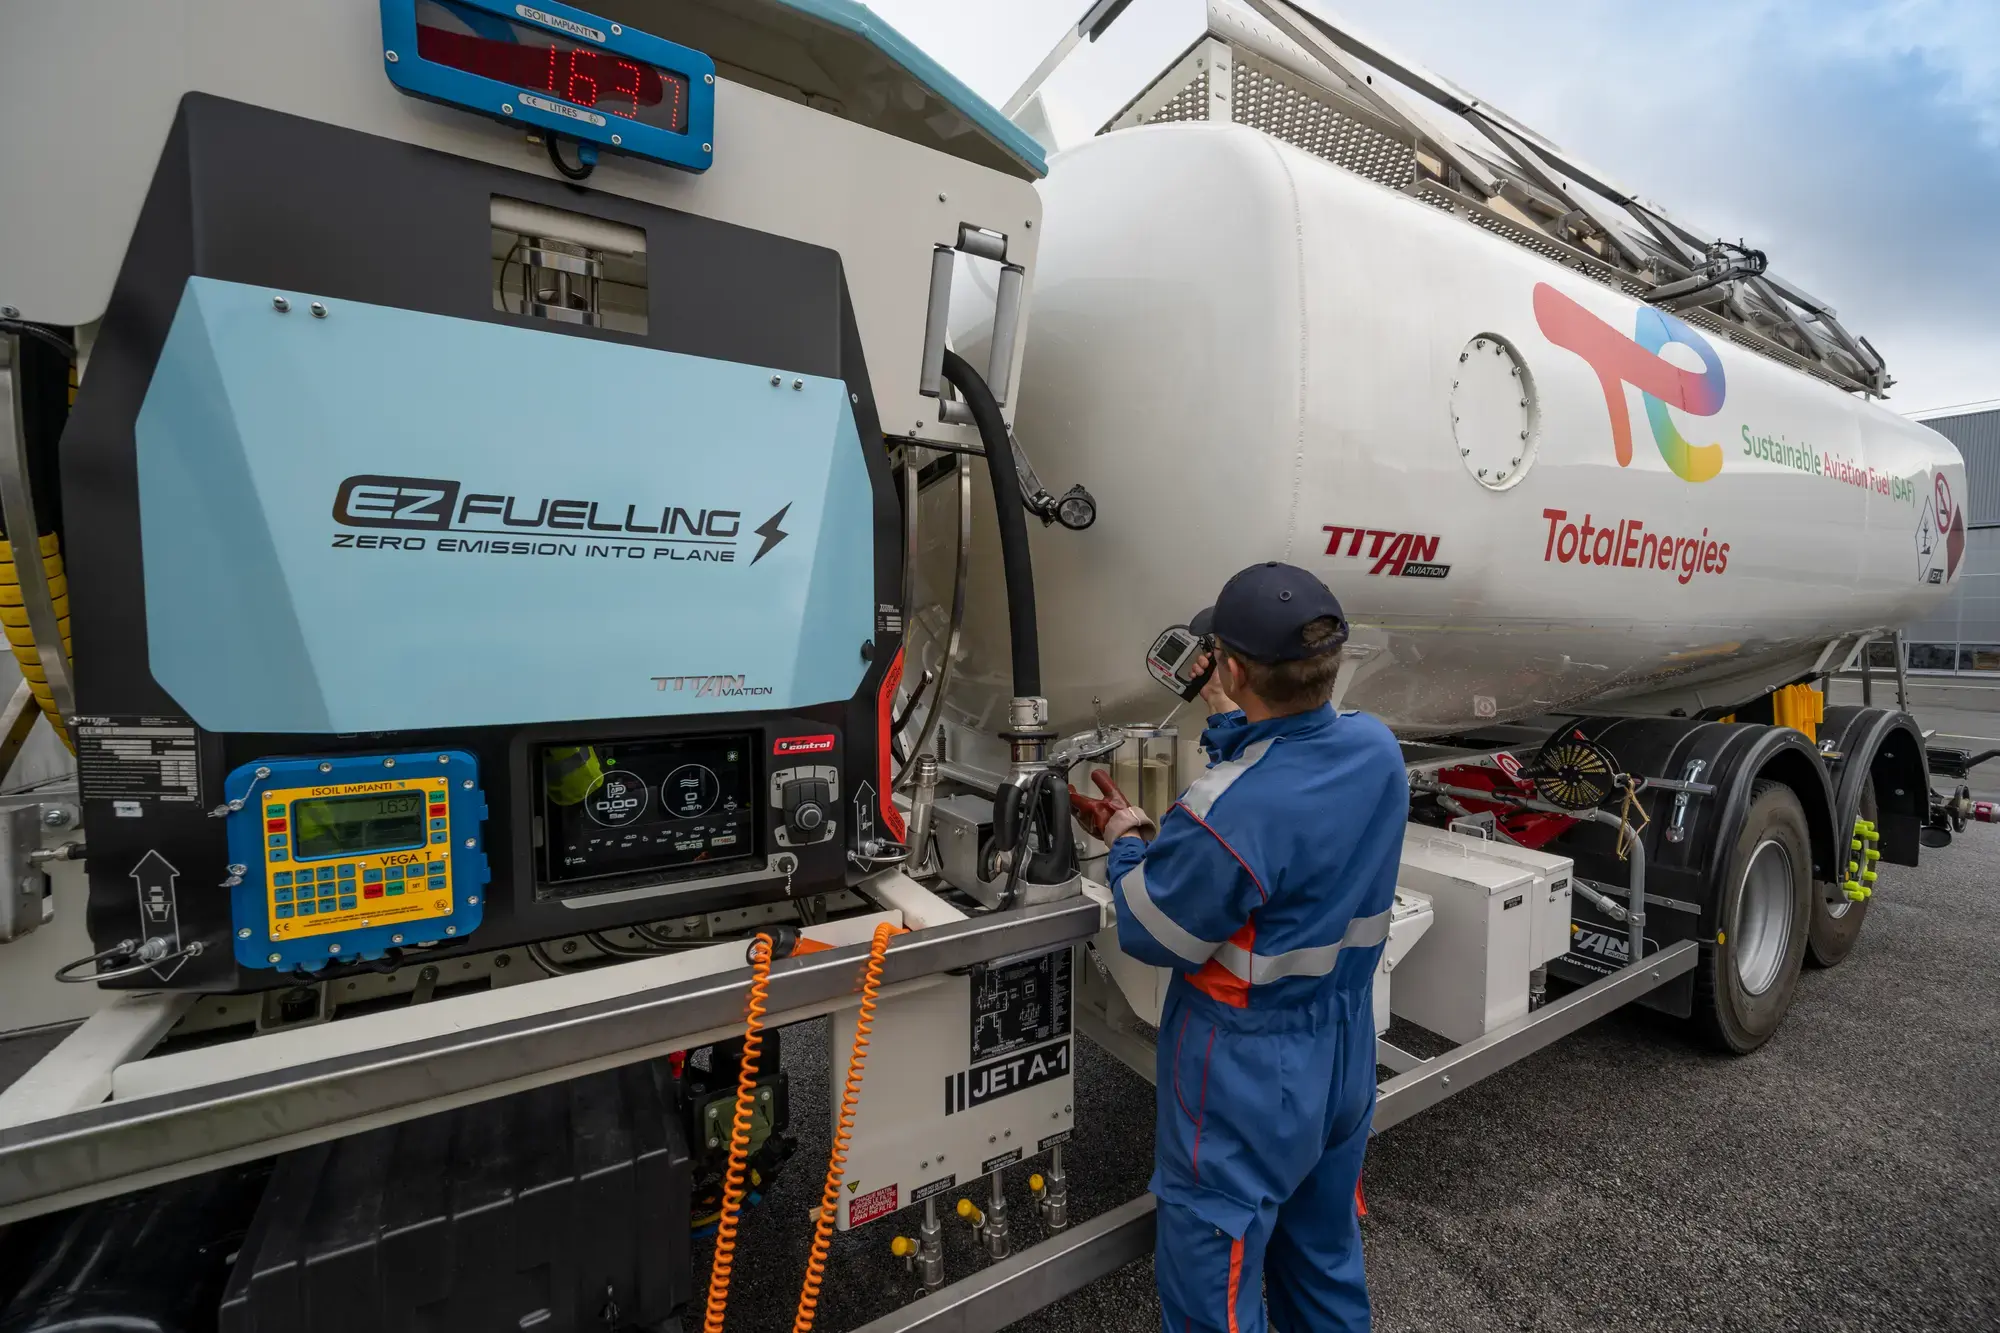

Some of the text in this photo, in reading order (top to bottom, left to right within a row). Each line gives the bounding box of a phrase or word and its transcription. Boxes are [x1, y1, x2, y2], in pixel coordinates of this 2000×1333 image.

[524, 7, 592, 38] ISOIL IMPIANTI
[548, 44, 680, 127] 1637
[549, 102, 577, 118] LITRES
[1741, 424, 1916, 508] Sustainable Aviation Fuel (SAF)
[345, 483, 741, 537] EZ FUELLING
[331, 534, 735, 563] ZERO EMISSION INTO PLANE
[1322, 525, 1441, 576] TITAN
[1542, 508, 1730, 585] TotalEnergies
[1405, 565, 1447, 576] AVIATION
[650, 675, 746, 698] TITAN
[789, 741, 830, 750] control
[311, 782, 392, 796] ISOIL IMPIANTI
[377, 797, 419, 815] 1637
[596, 798, 638, 811] 0.00
[380, 851, 432, 866] VEGA T
[1573, 928, 1630, 954] TAN
[973, 1059, 1025, 1098] JET
[1027, 1045, 1067, 1081] A-1
